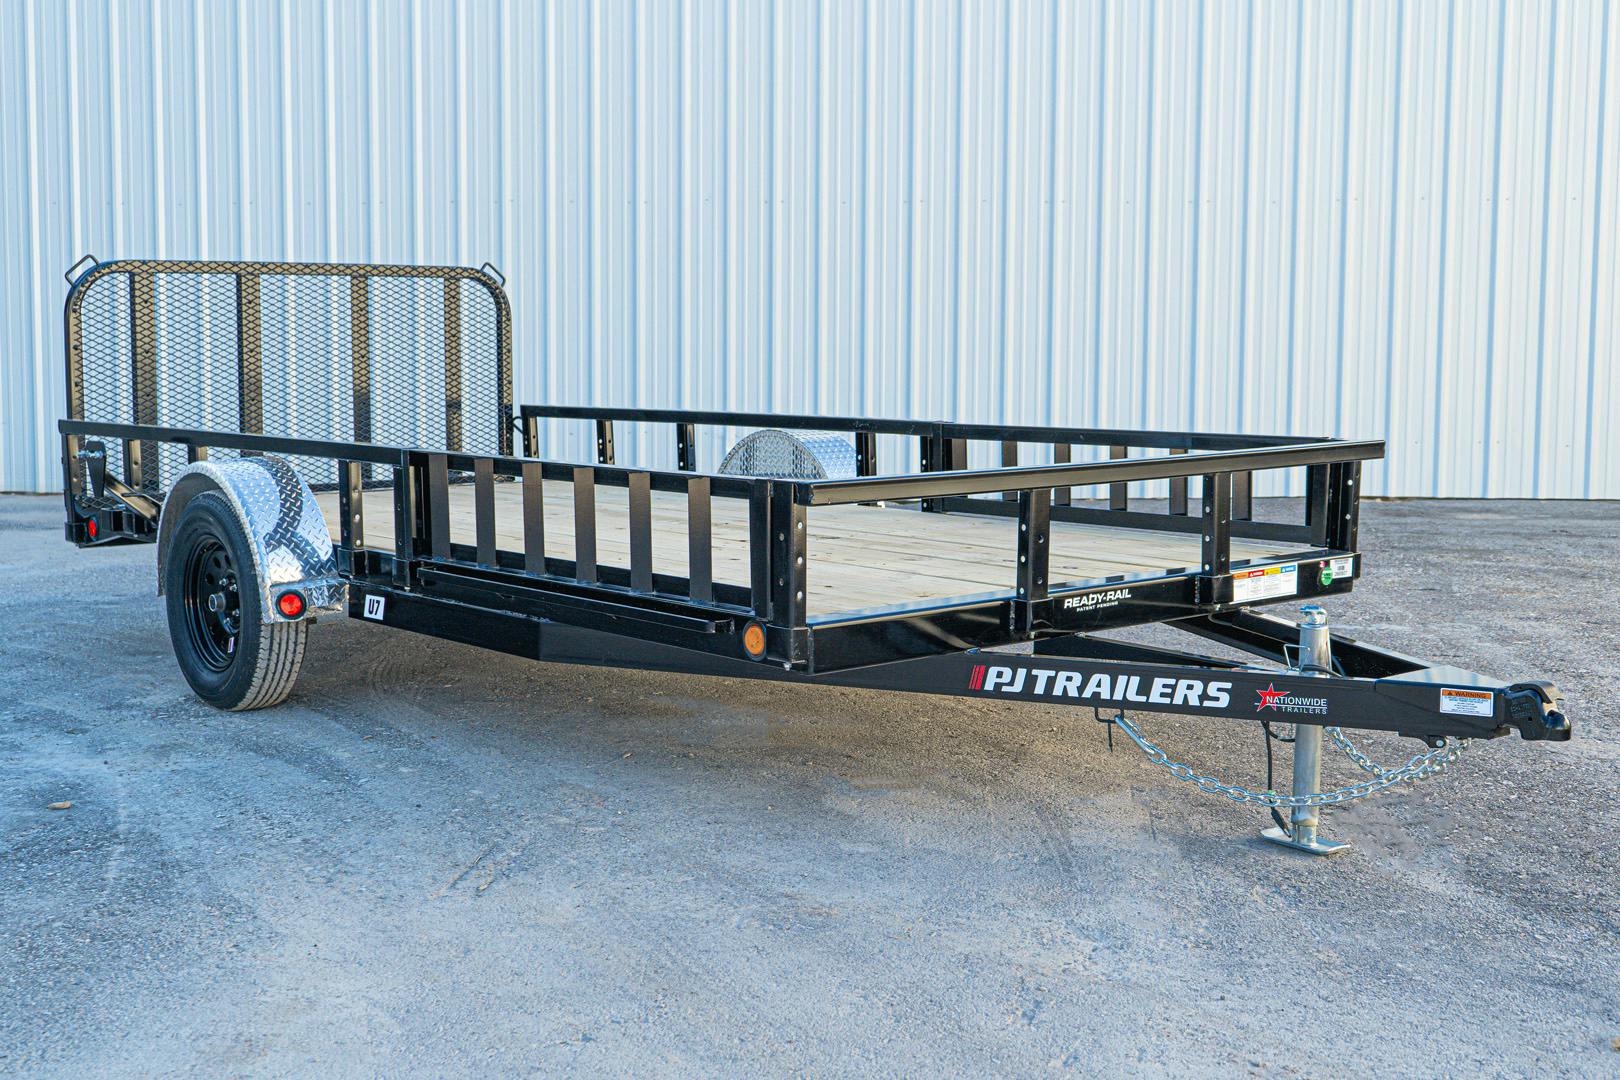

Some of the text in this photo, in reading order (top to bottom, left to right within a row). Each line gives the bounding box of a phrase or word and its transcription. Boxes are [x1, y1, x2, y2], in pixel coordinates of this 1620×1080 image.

[1063, 588, 1132, 609] READY-RAIL
[1076, 600, 1119, 612] PATENT PENDING
[368, 598, 381, 616] U7
[983, 666, 1233, 708] PJ TRAILERS
[1265, 695, 1328, 707] NATIONWIDE
[1281, 706, 1327, 715] TRAILERS
